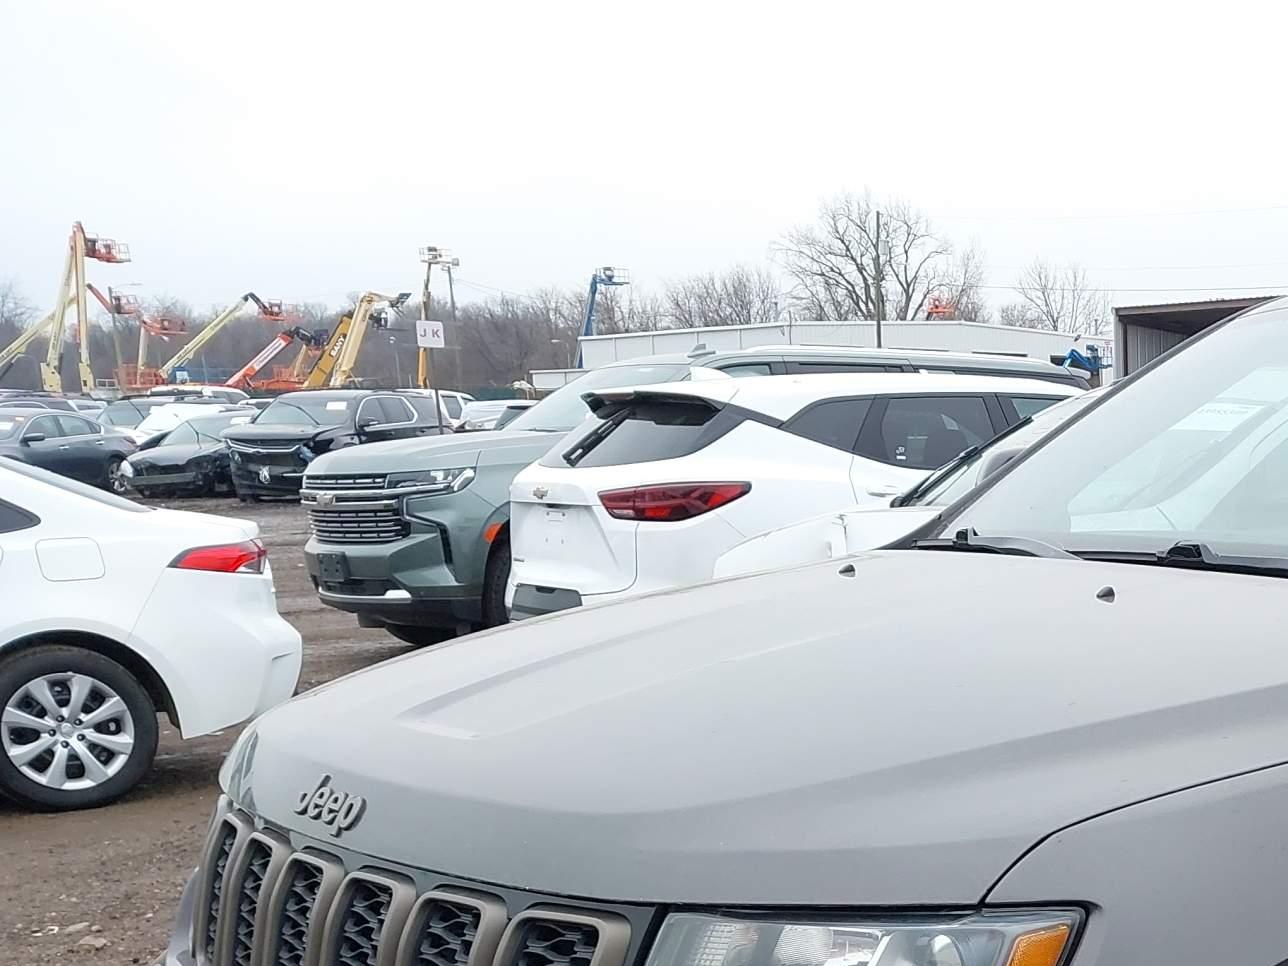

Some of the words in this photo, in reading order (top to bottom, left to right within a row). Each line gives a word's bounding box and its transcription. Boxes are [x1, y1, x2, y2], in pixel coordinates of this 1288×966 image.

[419, 328, 427, 338] J
[431, 328, 441, 338] K
[293, 773, 366, 838] Jeep
